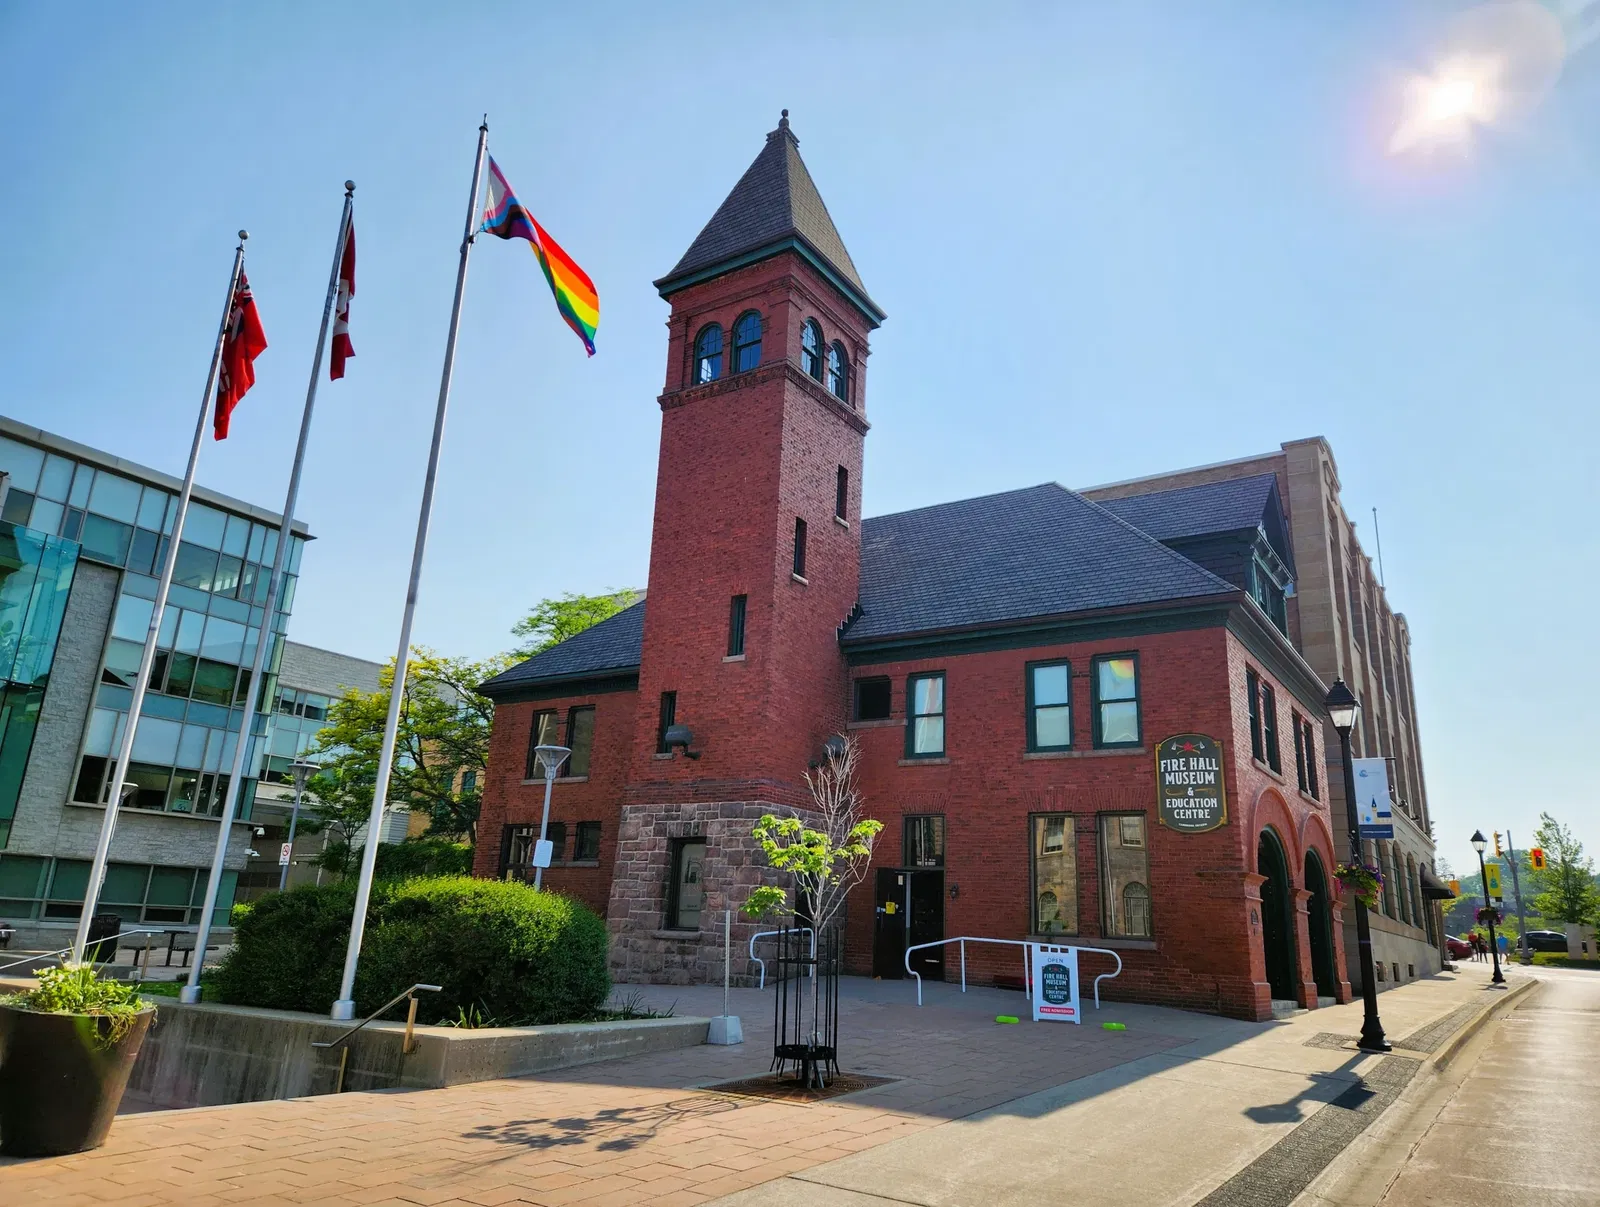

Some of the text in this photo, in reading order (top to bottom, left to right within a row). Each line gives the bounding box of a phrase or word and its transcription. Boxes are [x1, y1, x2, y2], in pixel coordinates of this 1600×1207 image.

[1160, 757, 1219, 772] FIRE HALL
[1165, 772, 1215, 785] MUSEUM
[1187, 787, 1194, 796] &
[1165, 798, 1218, 808] EDUCATION
[1174, 809, 1211, 819] CENTRE
